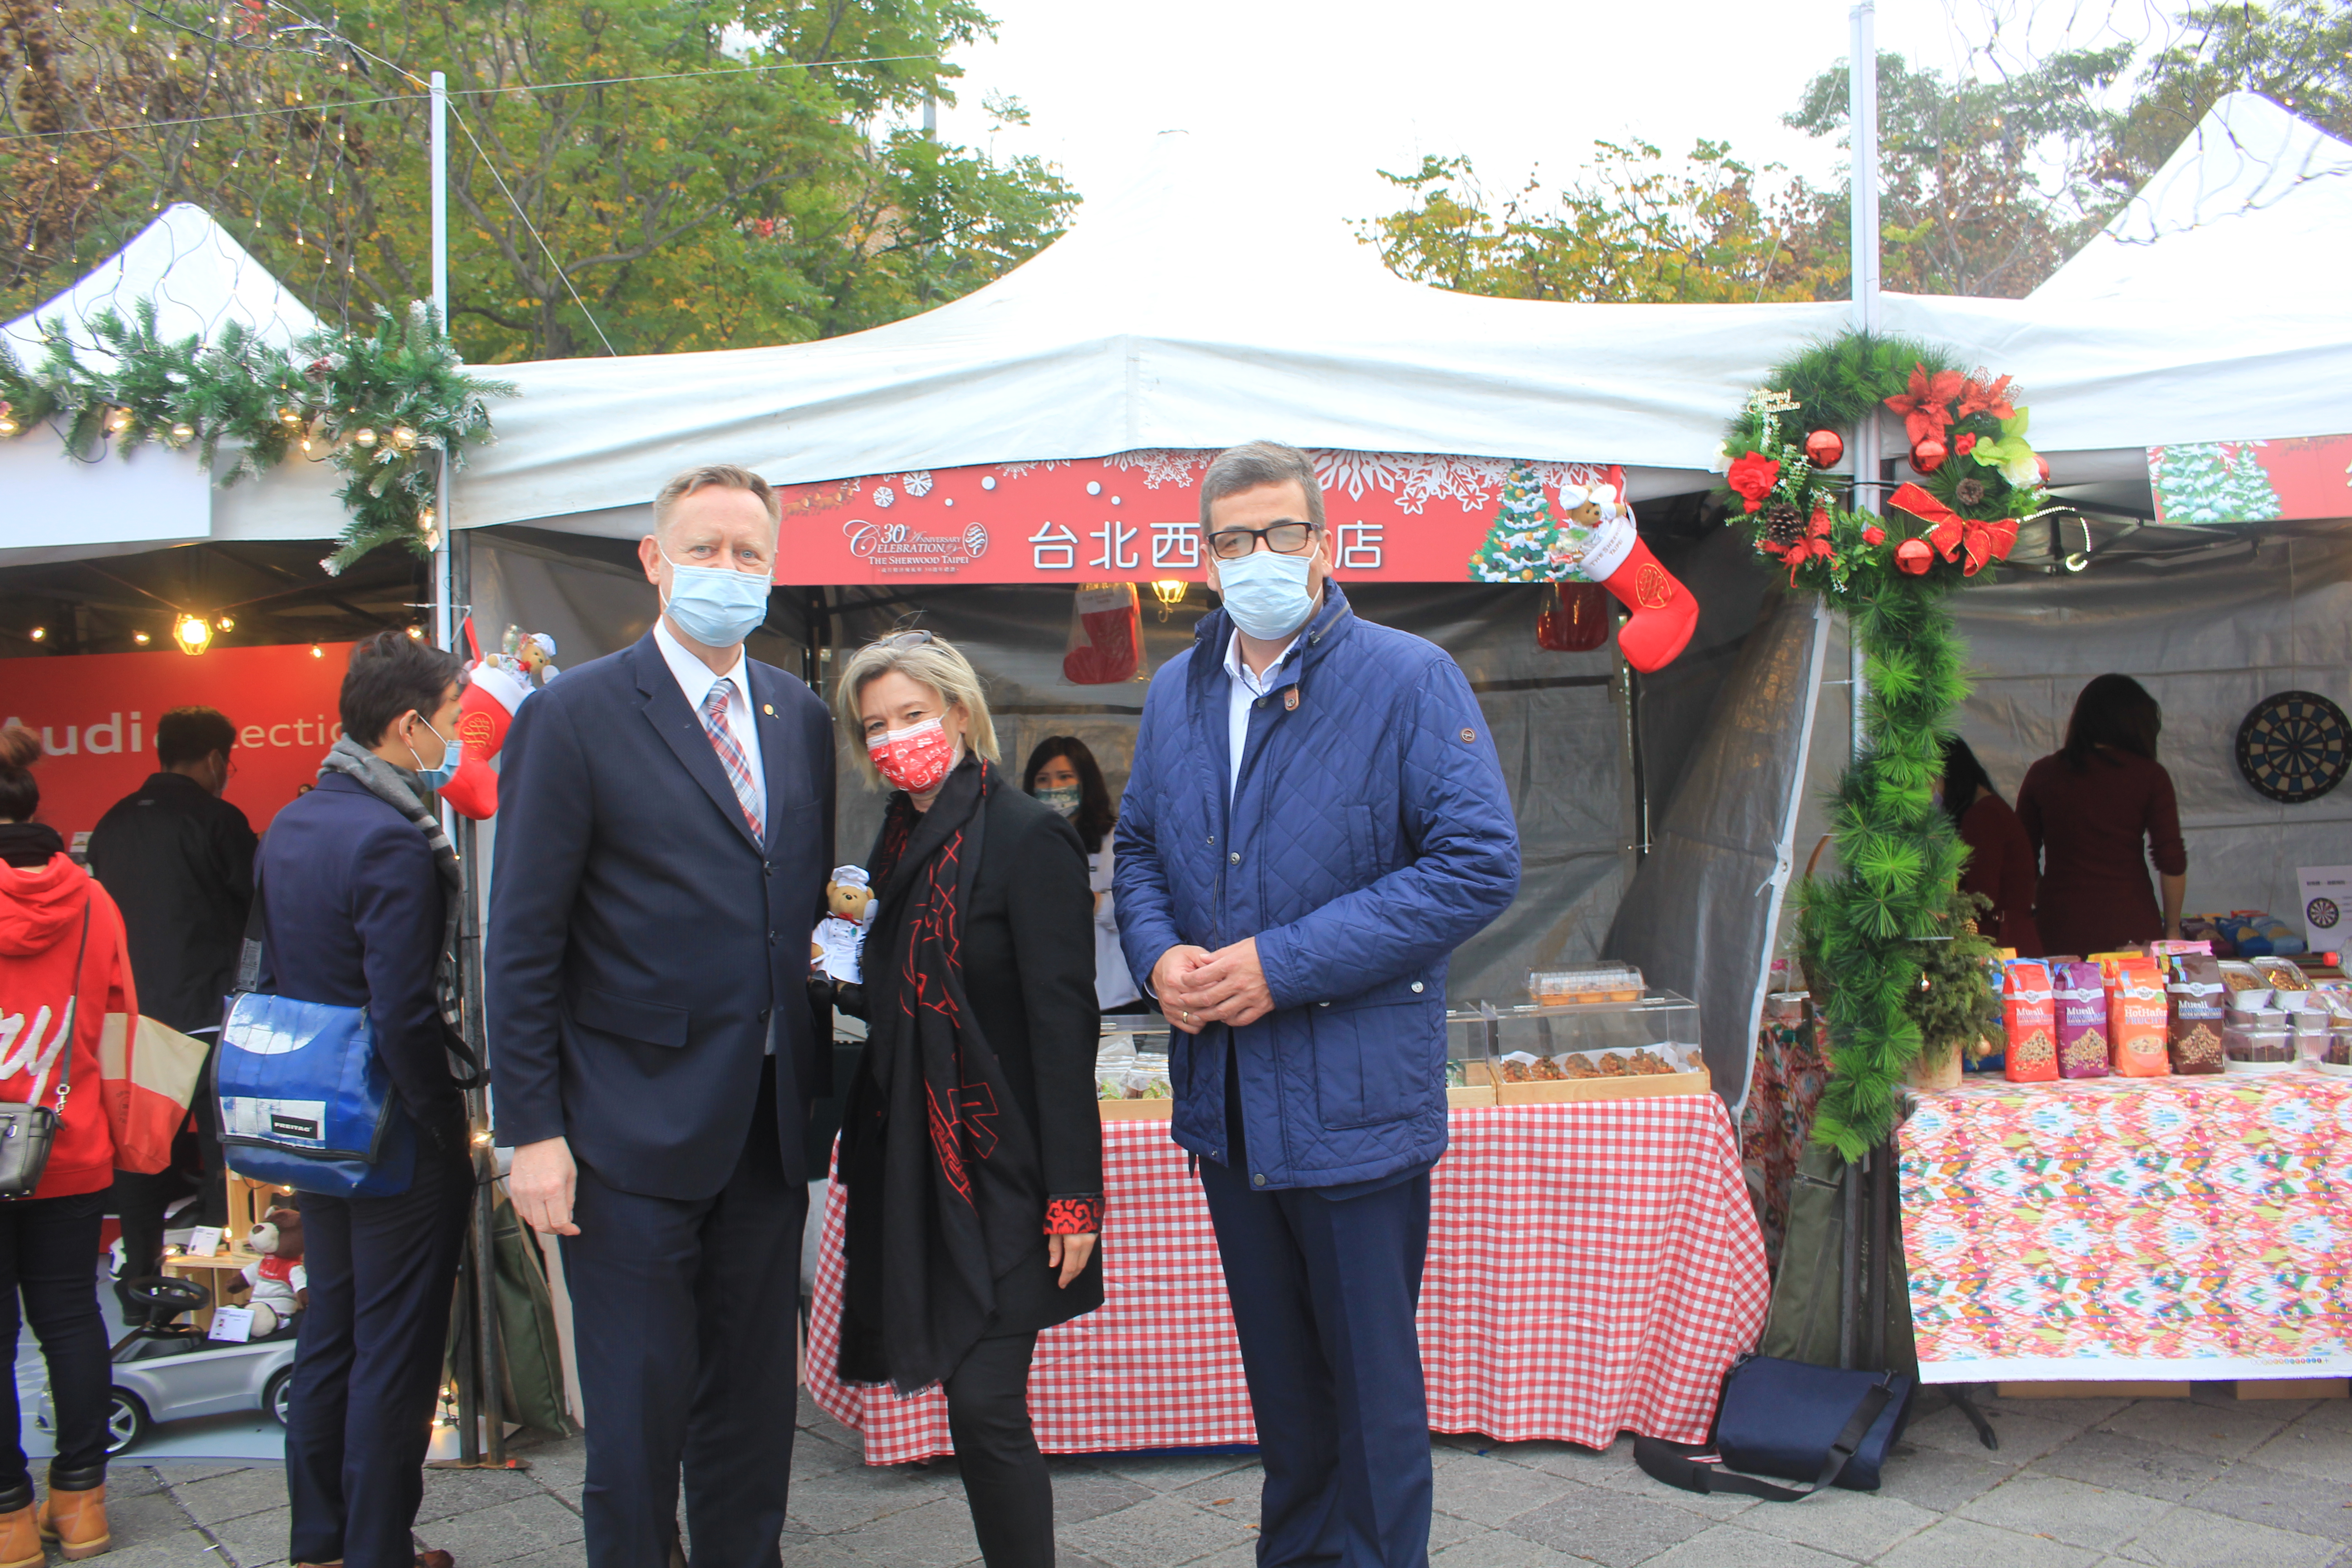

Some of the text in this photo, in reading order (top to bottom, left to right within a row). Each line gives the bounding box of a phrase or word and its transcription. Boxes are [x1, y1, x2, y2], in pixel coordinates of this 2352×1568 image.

[868, 555, 969, 565] THE SHERWOOD TAIPEI
[1589, 553, 1604, 566] THE
[274, 1122, 310, 1132] FREITAG
